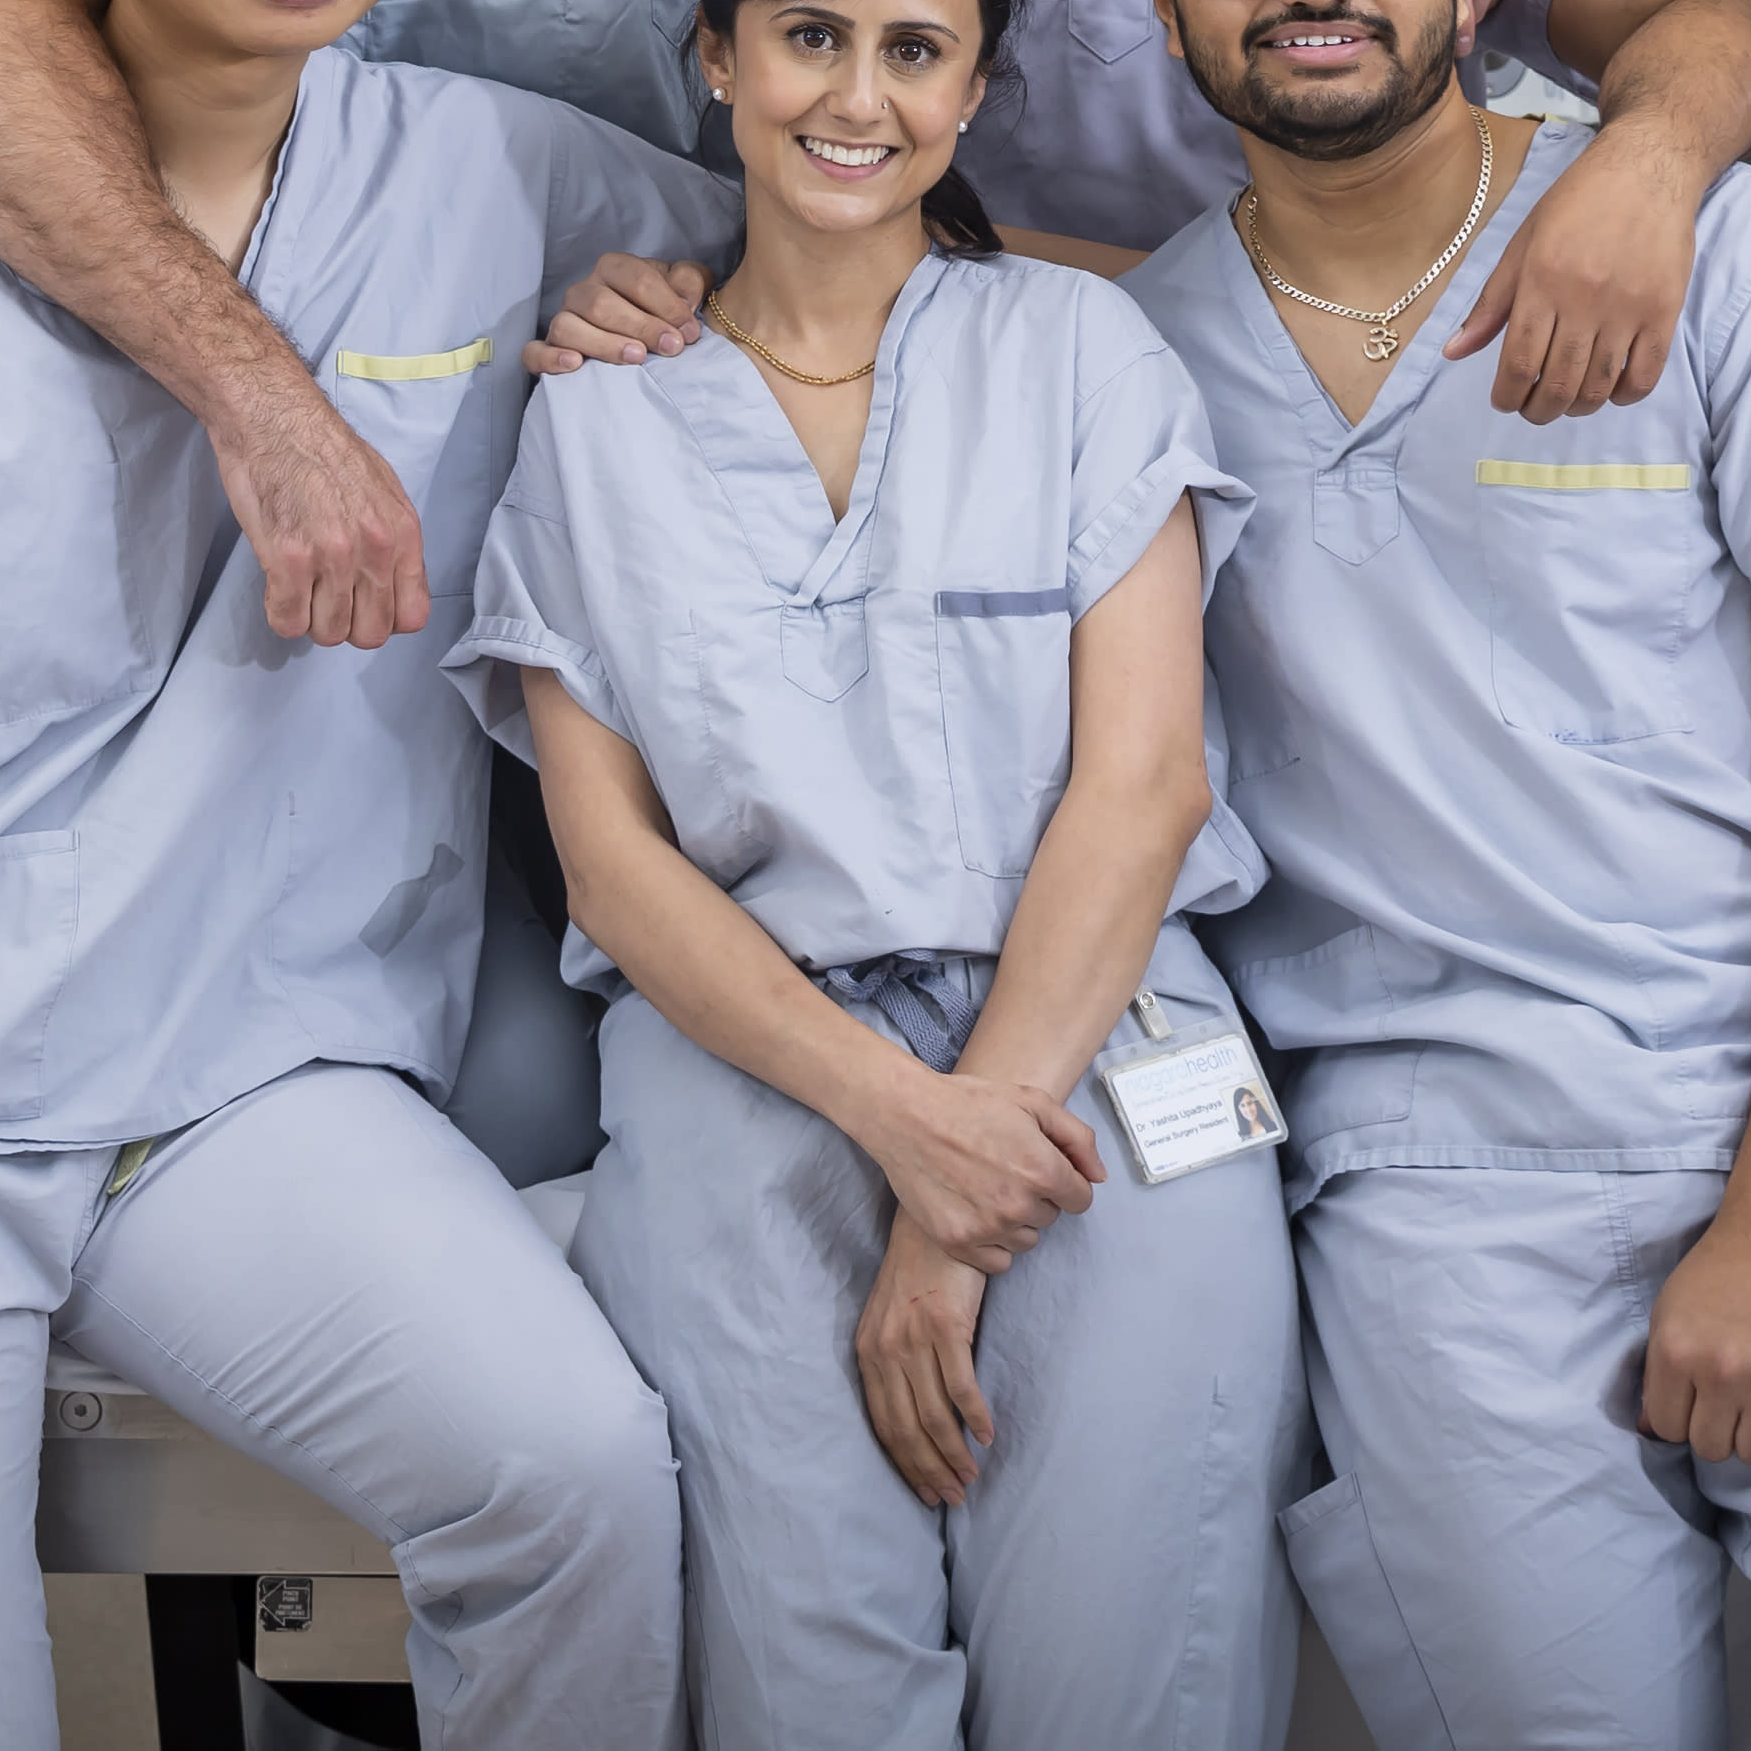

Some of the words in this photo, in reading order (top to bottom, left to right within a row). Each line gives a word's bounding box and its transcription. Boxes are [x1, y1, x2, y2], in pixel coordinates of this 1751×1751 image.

[1144, 1135, 1172, 1148] General
[1172, 1127, 1198, 1139] Surgery
[1199, 1116, 1229, 1129] Resident
[1150, 1114, 1179, 1128] Yashita
